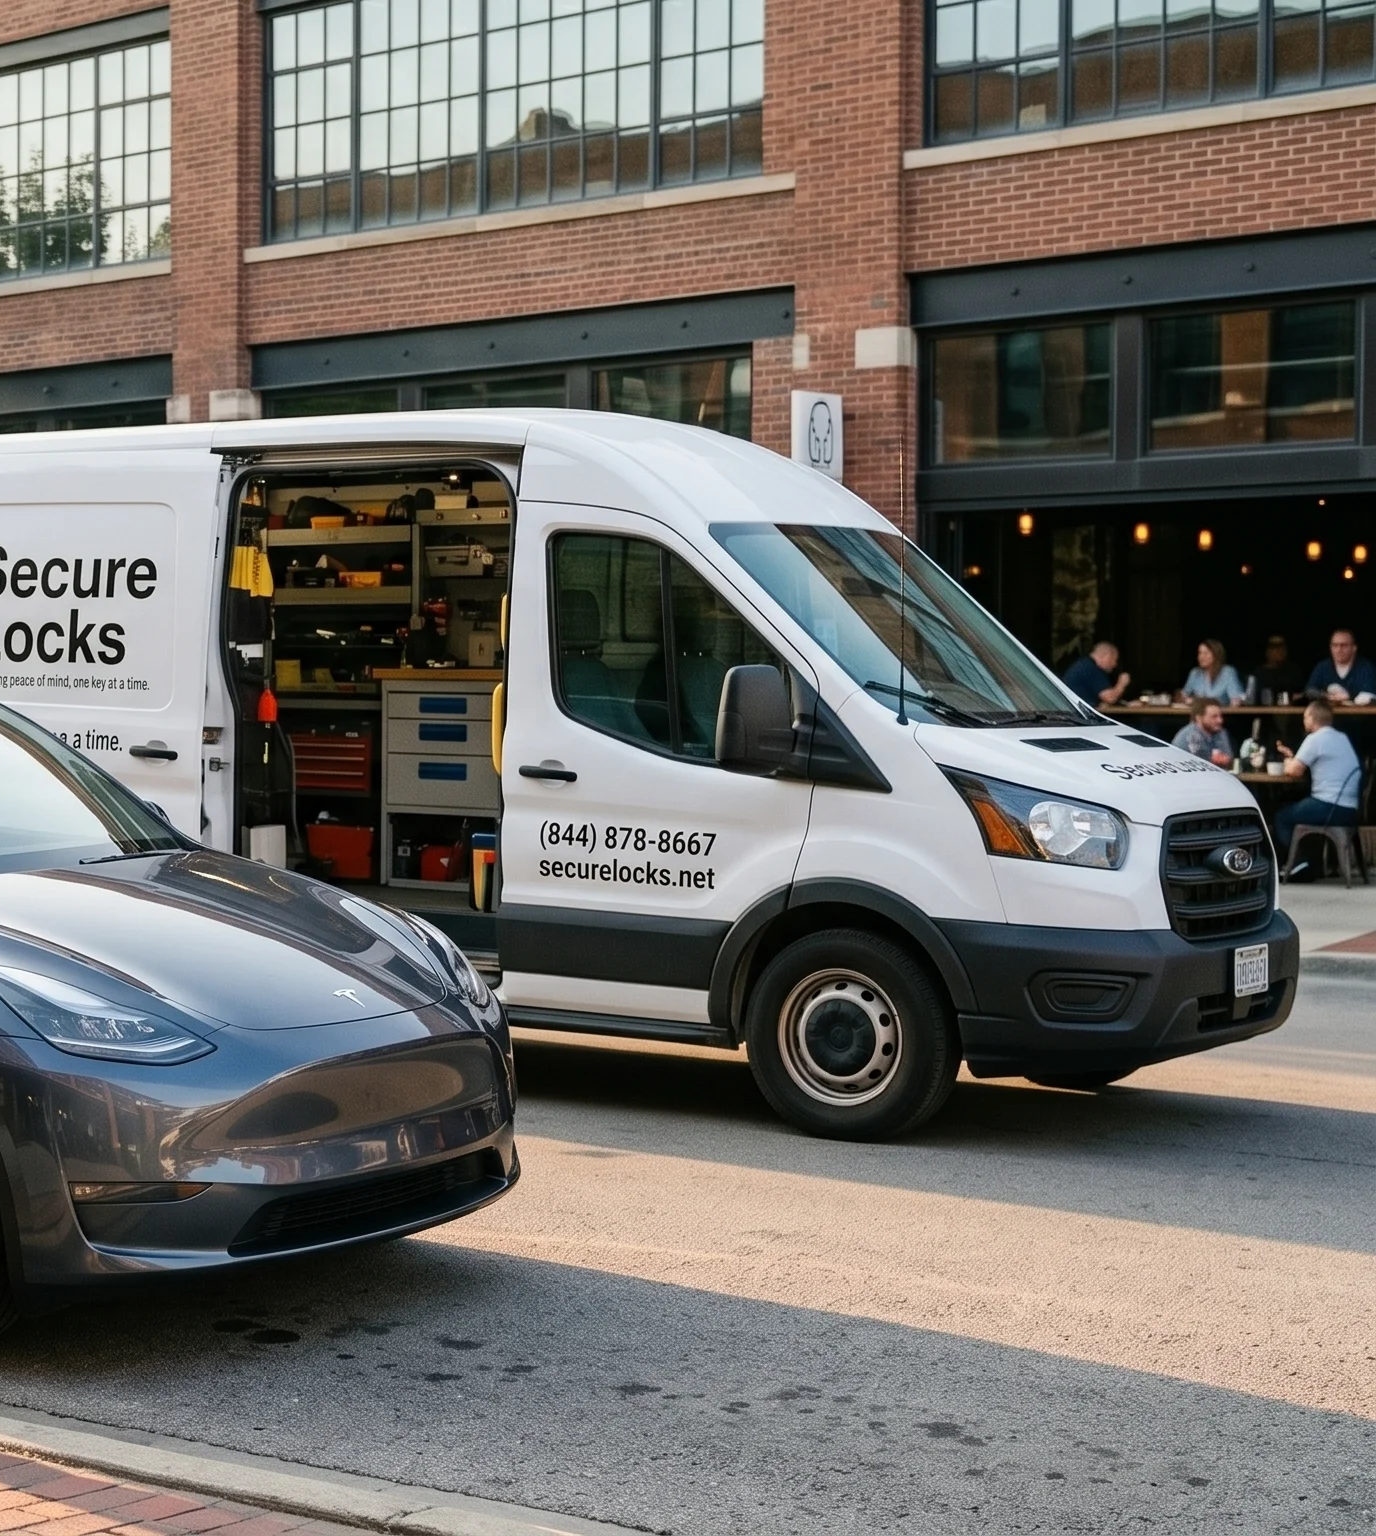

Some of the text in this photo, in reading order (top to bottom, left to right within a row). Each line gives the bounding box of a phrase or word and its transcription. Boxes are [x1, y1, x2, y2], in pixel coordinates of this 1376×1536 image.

[9, 676, 35, 689] peace
[36, 674, 46, 687] of
[47, 674, 72, 690] mind,
[73, 678, 90, 689] one
[91, 676, 107, 691] key
[108, 677, 118, 690] at
[119, 679, 125, 690] a
[126, 676, 150, 691] time.
[73, 734, 82, 750] a
[86, 729, 123, 752] time.
[540, 820, 717, 857] (844) 878-8667
[539, 858, 715, 890] securelocks.net
